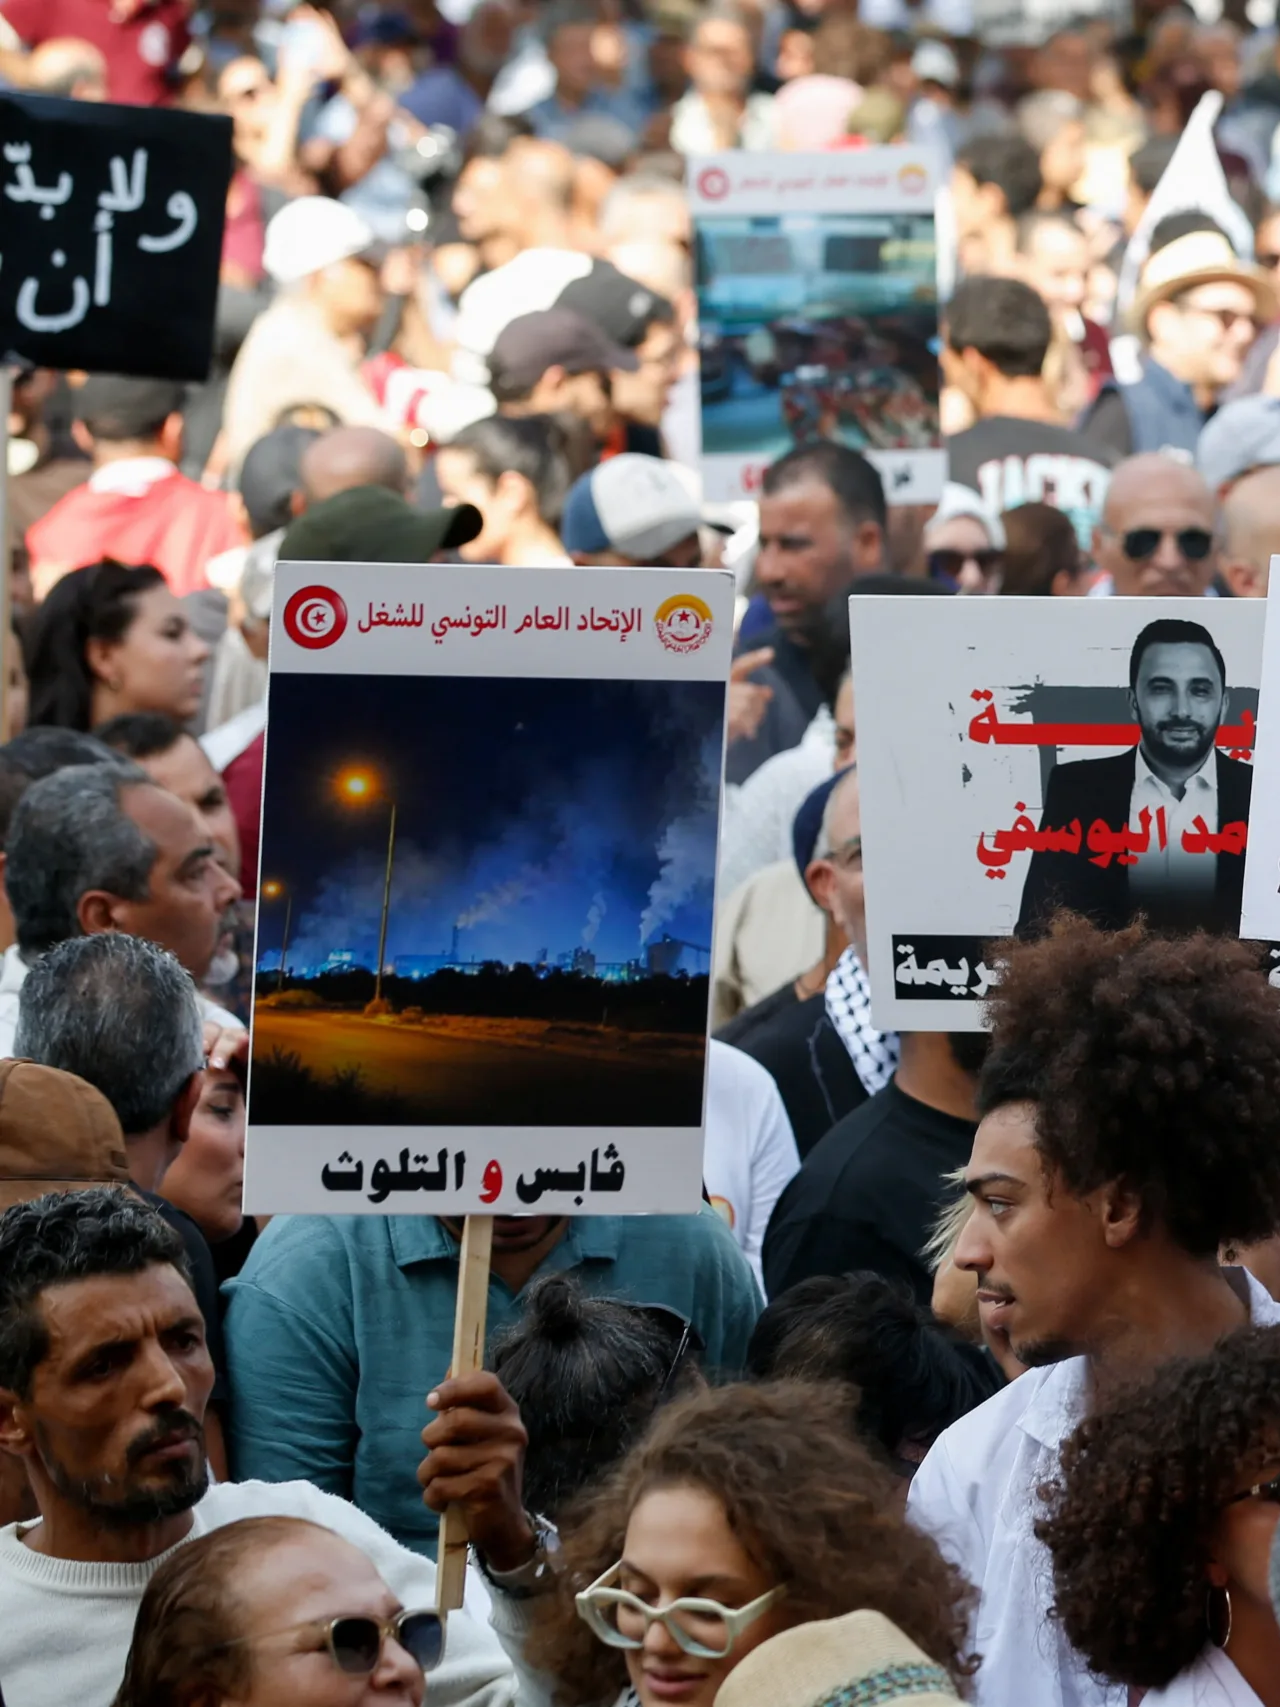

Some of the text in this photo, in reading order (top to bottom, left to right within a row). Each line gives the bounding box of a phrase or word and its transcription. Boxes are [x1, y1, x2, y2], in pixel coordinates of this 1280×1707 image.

[16, 208, 114, 333] أن
[358, 602, 424, 633] للشغل
[431, 604, 506, 645] التونسي
[515, 606, 569, 634] العام
[976, 801, 1168, 880] اليوسفي
[321, 1147, 466, 1204] التلوث
[479, 1159, 504, 1204] و
